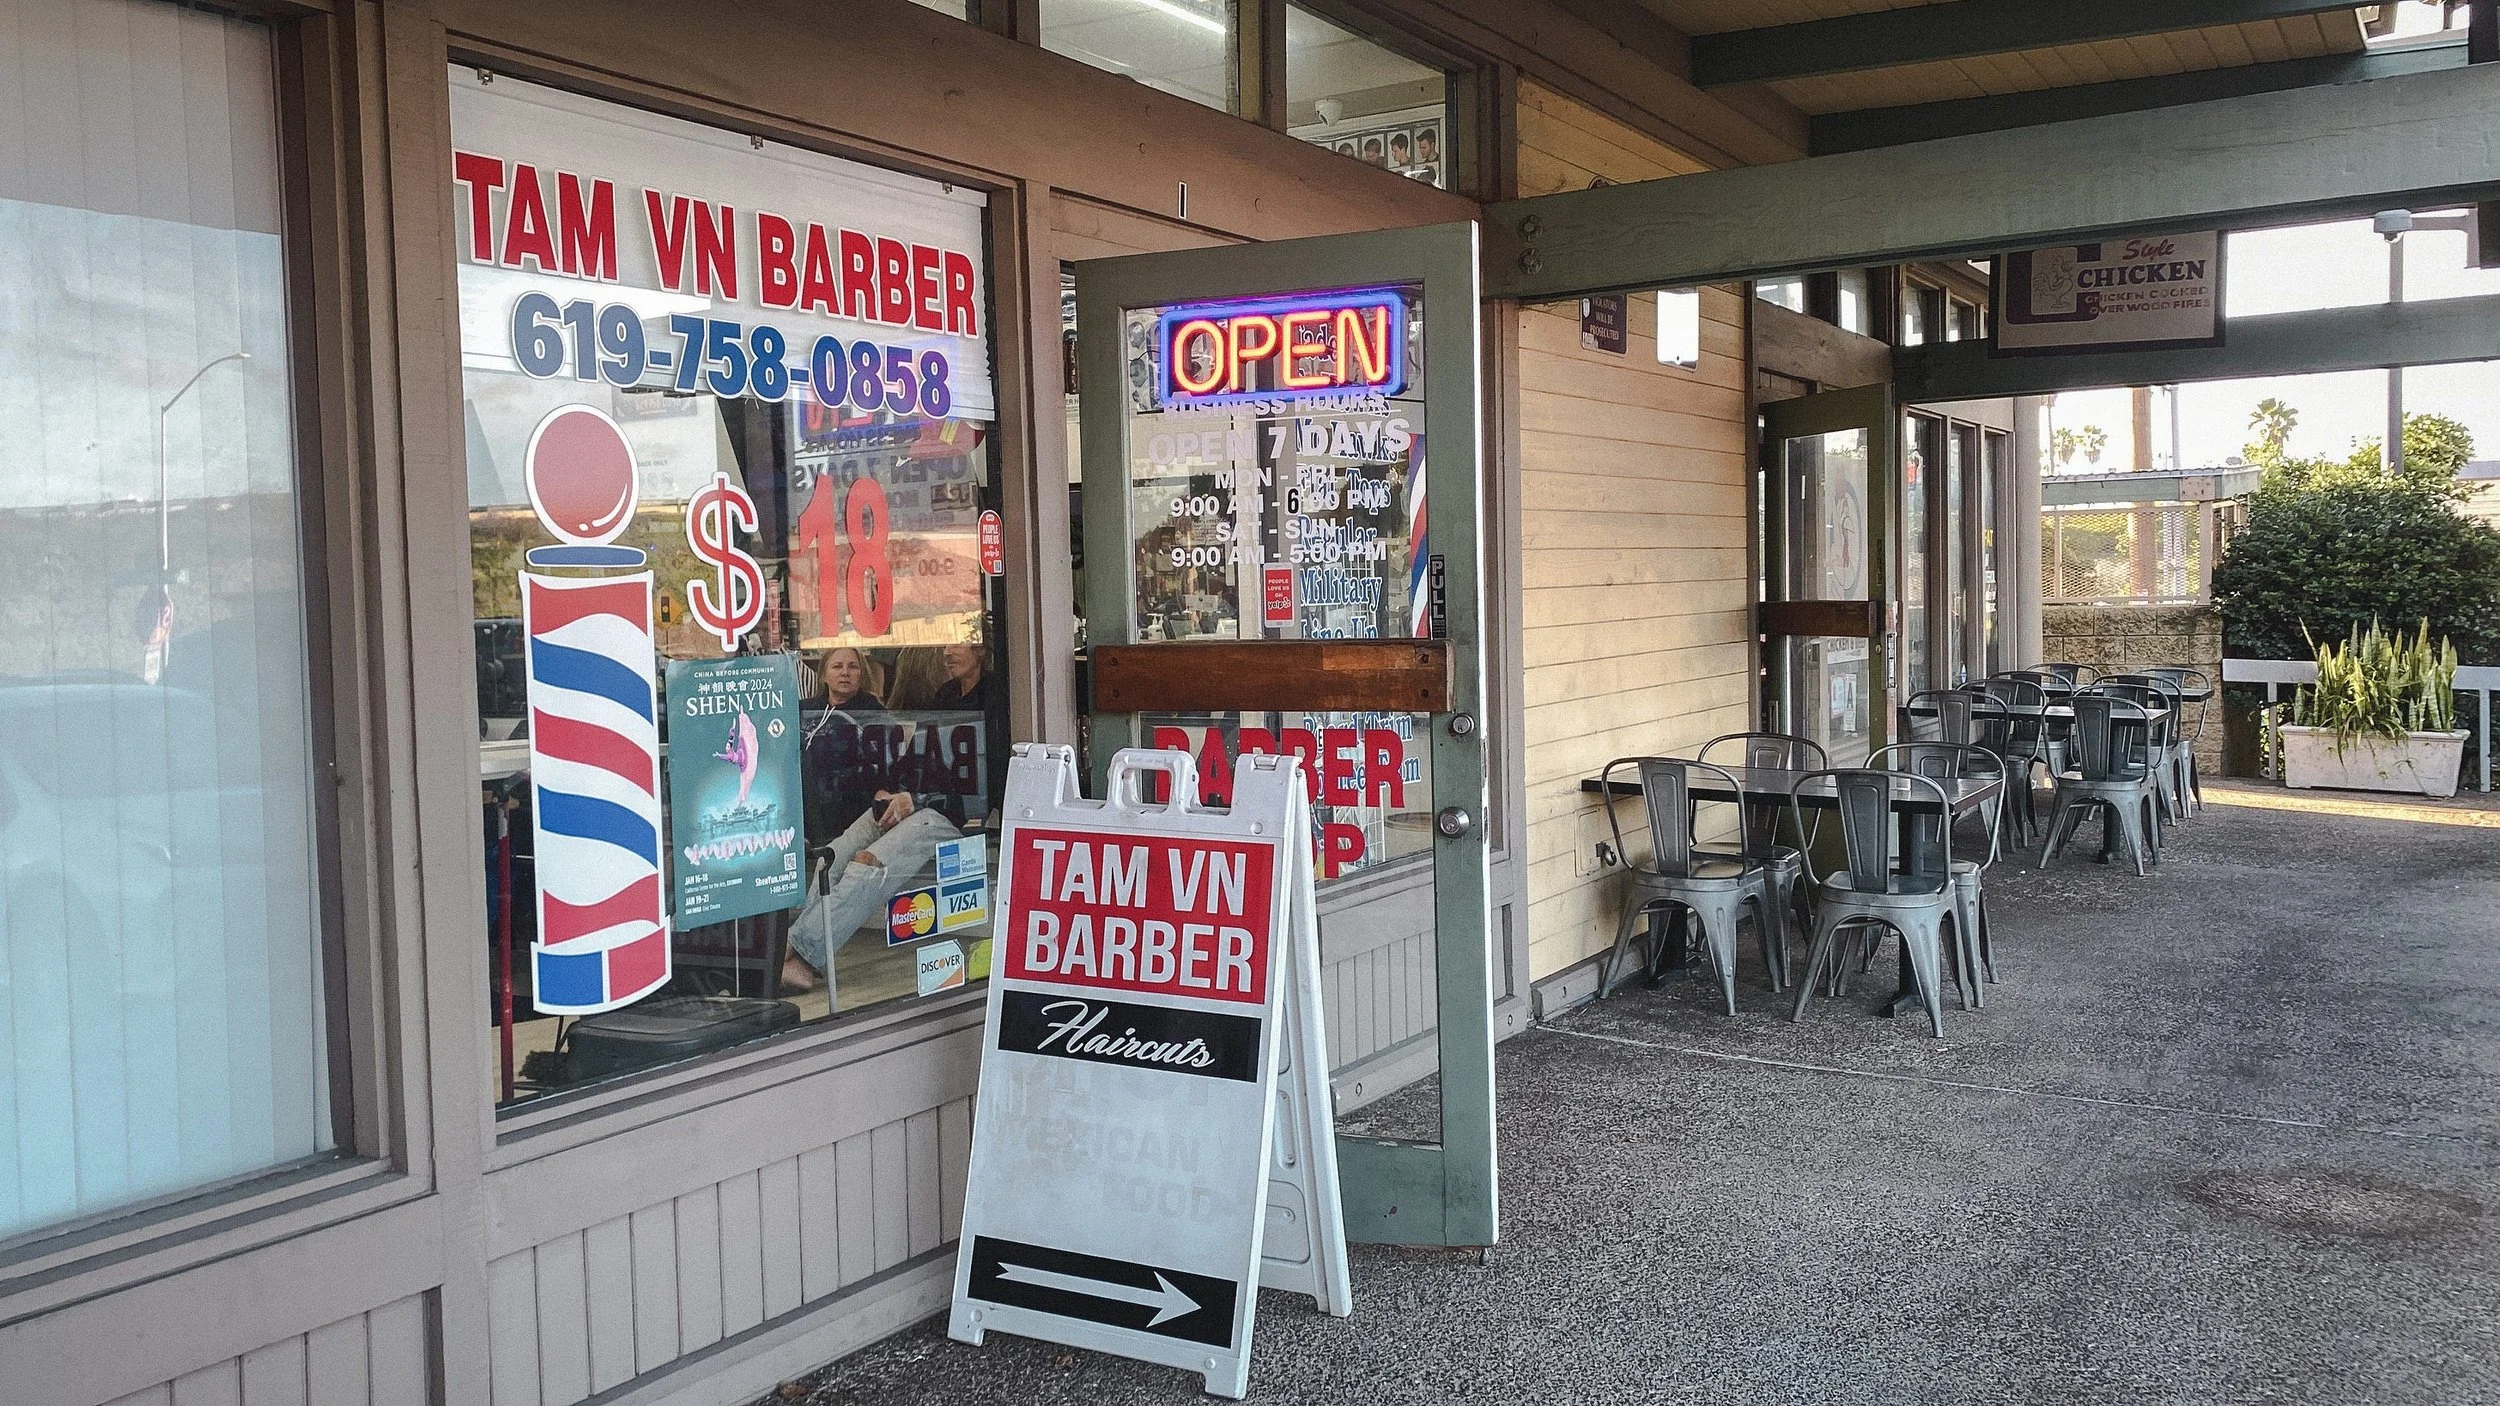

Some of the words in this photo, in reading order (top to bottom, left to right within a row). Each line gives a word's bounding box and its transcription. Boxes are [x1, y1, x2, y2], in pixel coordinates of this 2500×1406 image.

[453, 150, 619, 281] TAM
[642, 187, 739, 301] VN
[756, 210, 979, 337] BARBER
[2122, 238, 2176, 262] Style
[2077, 260, 2207, 289] CHICKEN
[2085, 290, 2145, 304] CHICKEN
[2149, 286, 2209, 300] COOKED
[2090, 301, 2126, 314] OVER
[511, 291, 951, 419] 619-758-0858
[1173, 305, 1388, 393] OPEN
[1164, 396, 1287, 420] BUSINESS
[1295, 390, 1386, 412] HOURS
[1148, 429, 1254, 465] OPEN
[1268, 426, 1287, 459] 7
[1302, 418, 1411, 456] DAYS
[1215, 467, 1272, 489] MON
[1170, 496, 1220, 517] 9:00
[1227, 494, 1264, 515] AM
[1347, 489, 1390, 510] PM
[983, 524, 999, 534] PEOPLE
[1216, 521, 1262, 541] SAT
[1285, 518, 1337, 539] SUN
[1171, 547, 1220, 567] 9:00
[1228, 545, 1265, 565] AM
[1290, 542, 1341, 564] 5:00
[1348, 541, 1387, 561] PM
[1300, 566, 1383, 613] Military
[1432, 560, 1444, 619] PULL
[693, 671, 714, 679] CHINA
[715, 669, 739, 677] BEFORE
[740, 666, 775, 676] COMMUNISM
[750, 678, 773, 691] 2024
[686, 694, 741, 717] SHEN
[744, 690, 784, 712] YUN
[1032, 839, 1149, 908] TAM
[1168, 848, 1247, 916] VN
[891, 905, 936, 927] MasterCard
[949, 892, 978, 914] VISA
[921, 954, 961, 974] DISCOVER
[1024, 910, 1254, 993] BARBER
[1037, 1001, 1216, 1068] Haircuts
